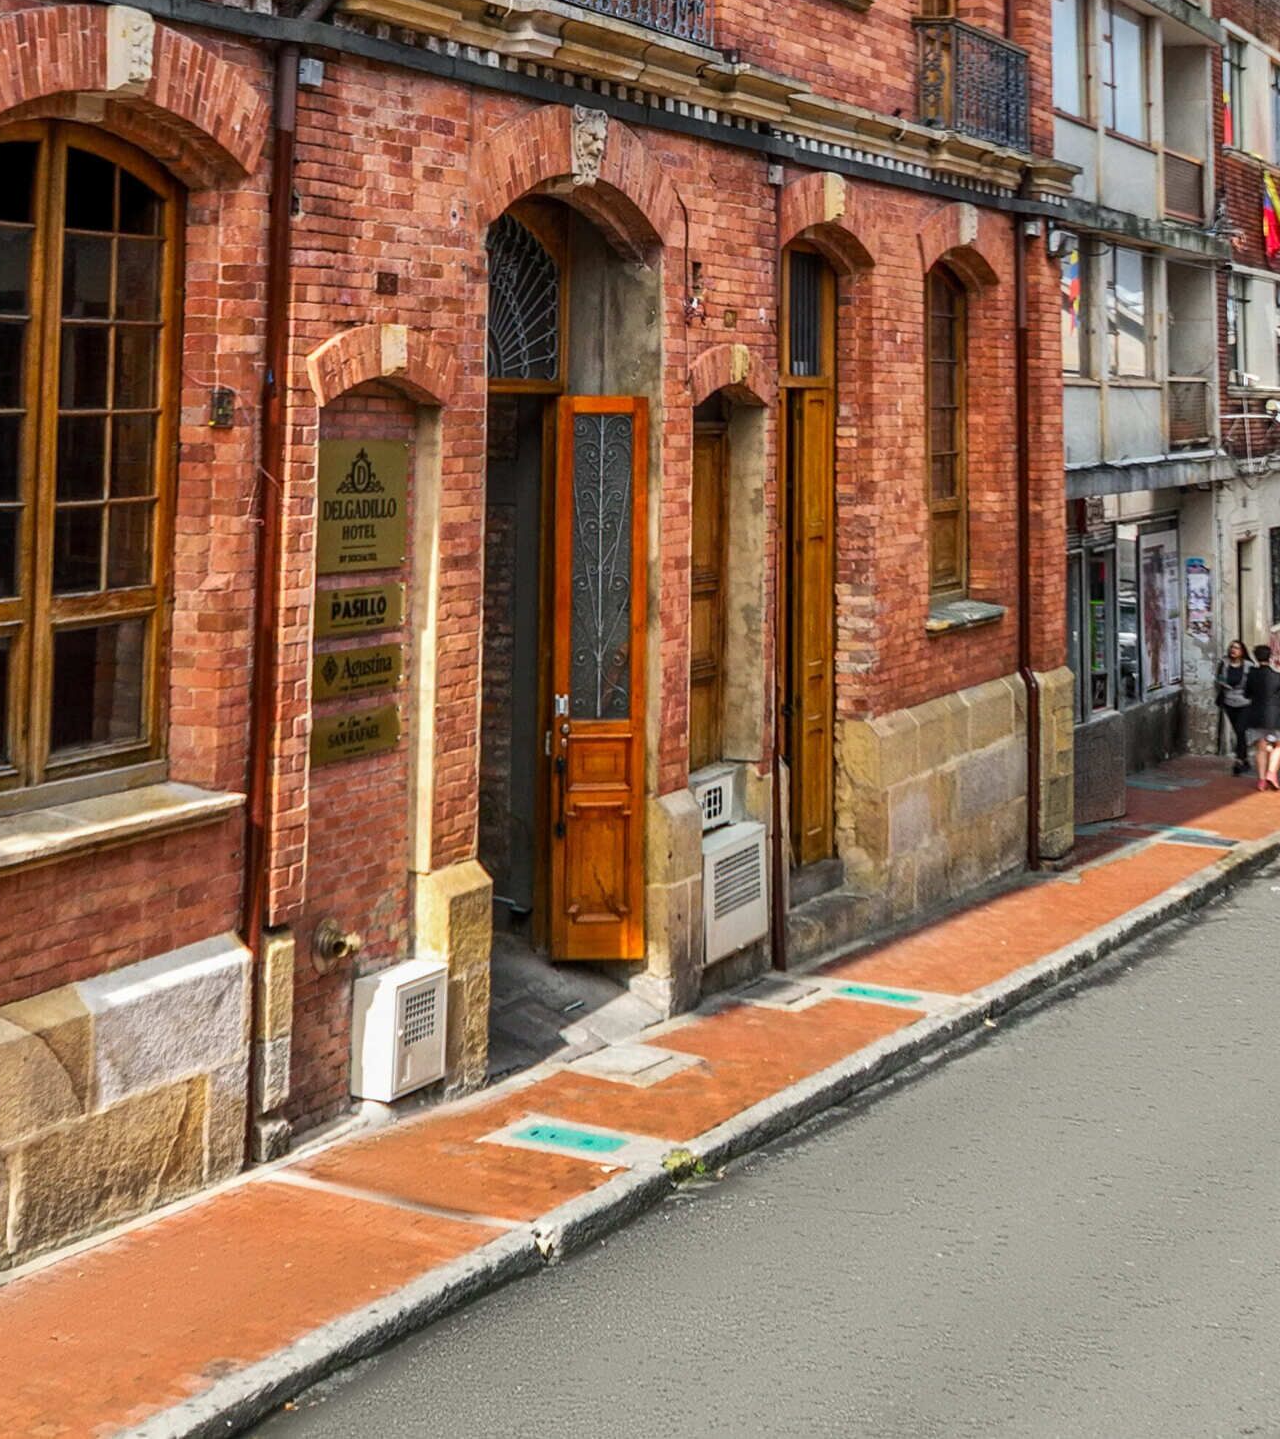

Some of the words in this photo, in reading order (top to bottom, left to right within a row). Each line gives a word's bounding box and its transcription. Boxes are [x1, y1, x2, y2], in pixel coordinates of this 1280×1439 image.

[323, 498, 397, 520] DELGADILLO
[342, 524, 376, 540] HOTEL
[331, 596, 387, 620] PASILLO
[342, 653, 392, 682] Agustina
